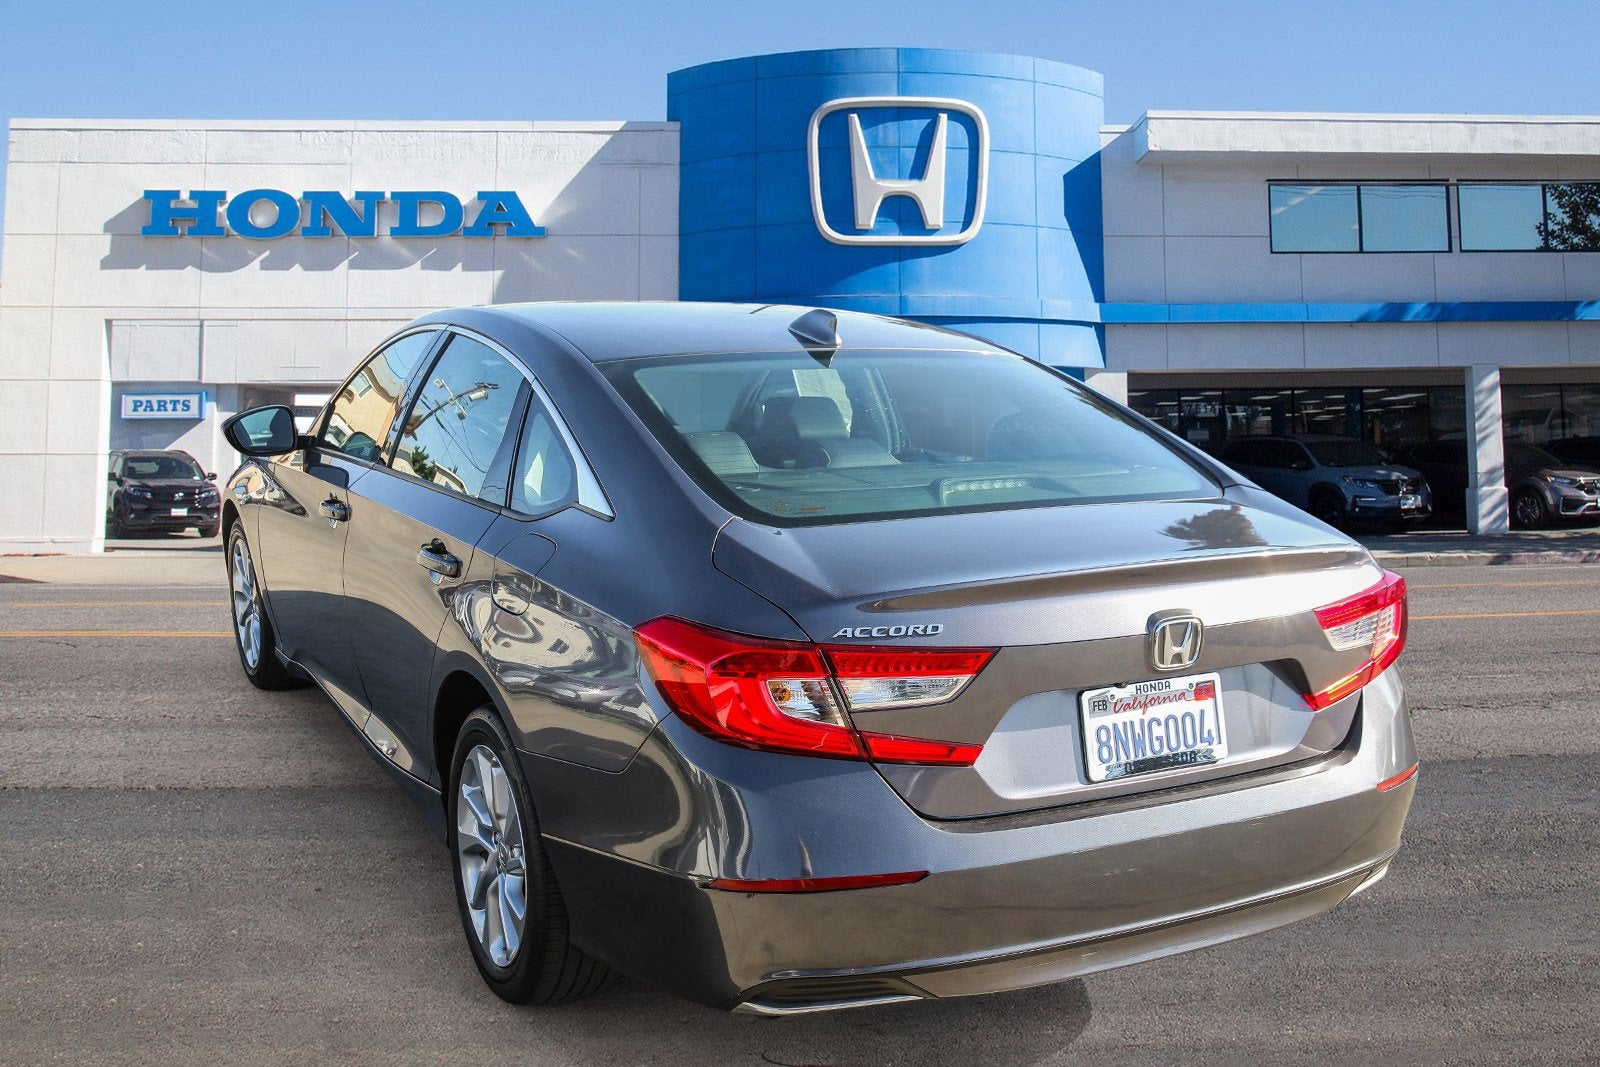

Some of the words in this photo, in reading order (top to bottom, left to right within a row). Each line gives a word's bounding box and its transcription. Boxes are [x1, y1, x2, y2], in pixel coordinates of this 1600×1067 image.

[141, 189, 547, 239] HONDA
[132, 400, 191, 412] PARTS
[830, 624, 944, 639] ACCORD
[1135, 681, 1171, 695] HONDA
[1093, 700, 1108, 711] FEB
[1113, 691, 1195, 715] California
[1096, 709, 1215, 765] 8NWG004
